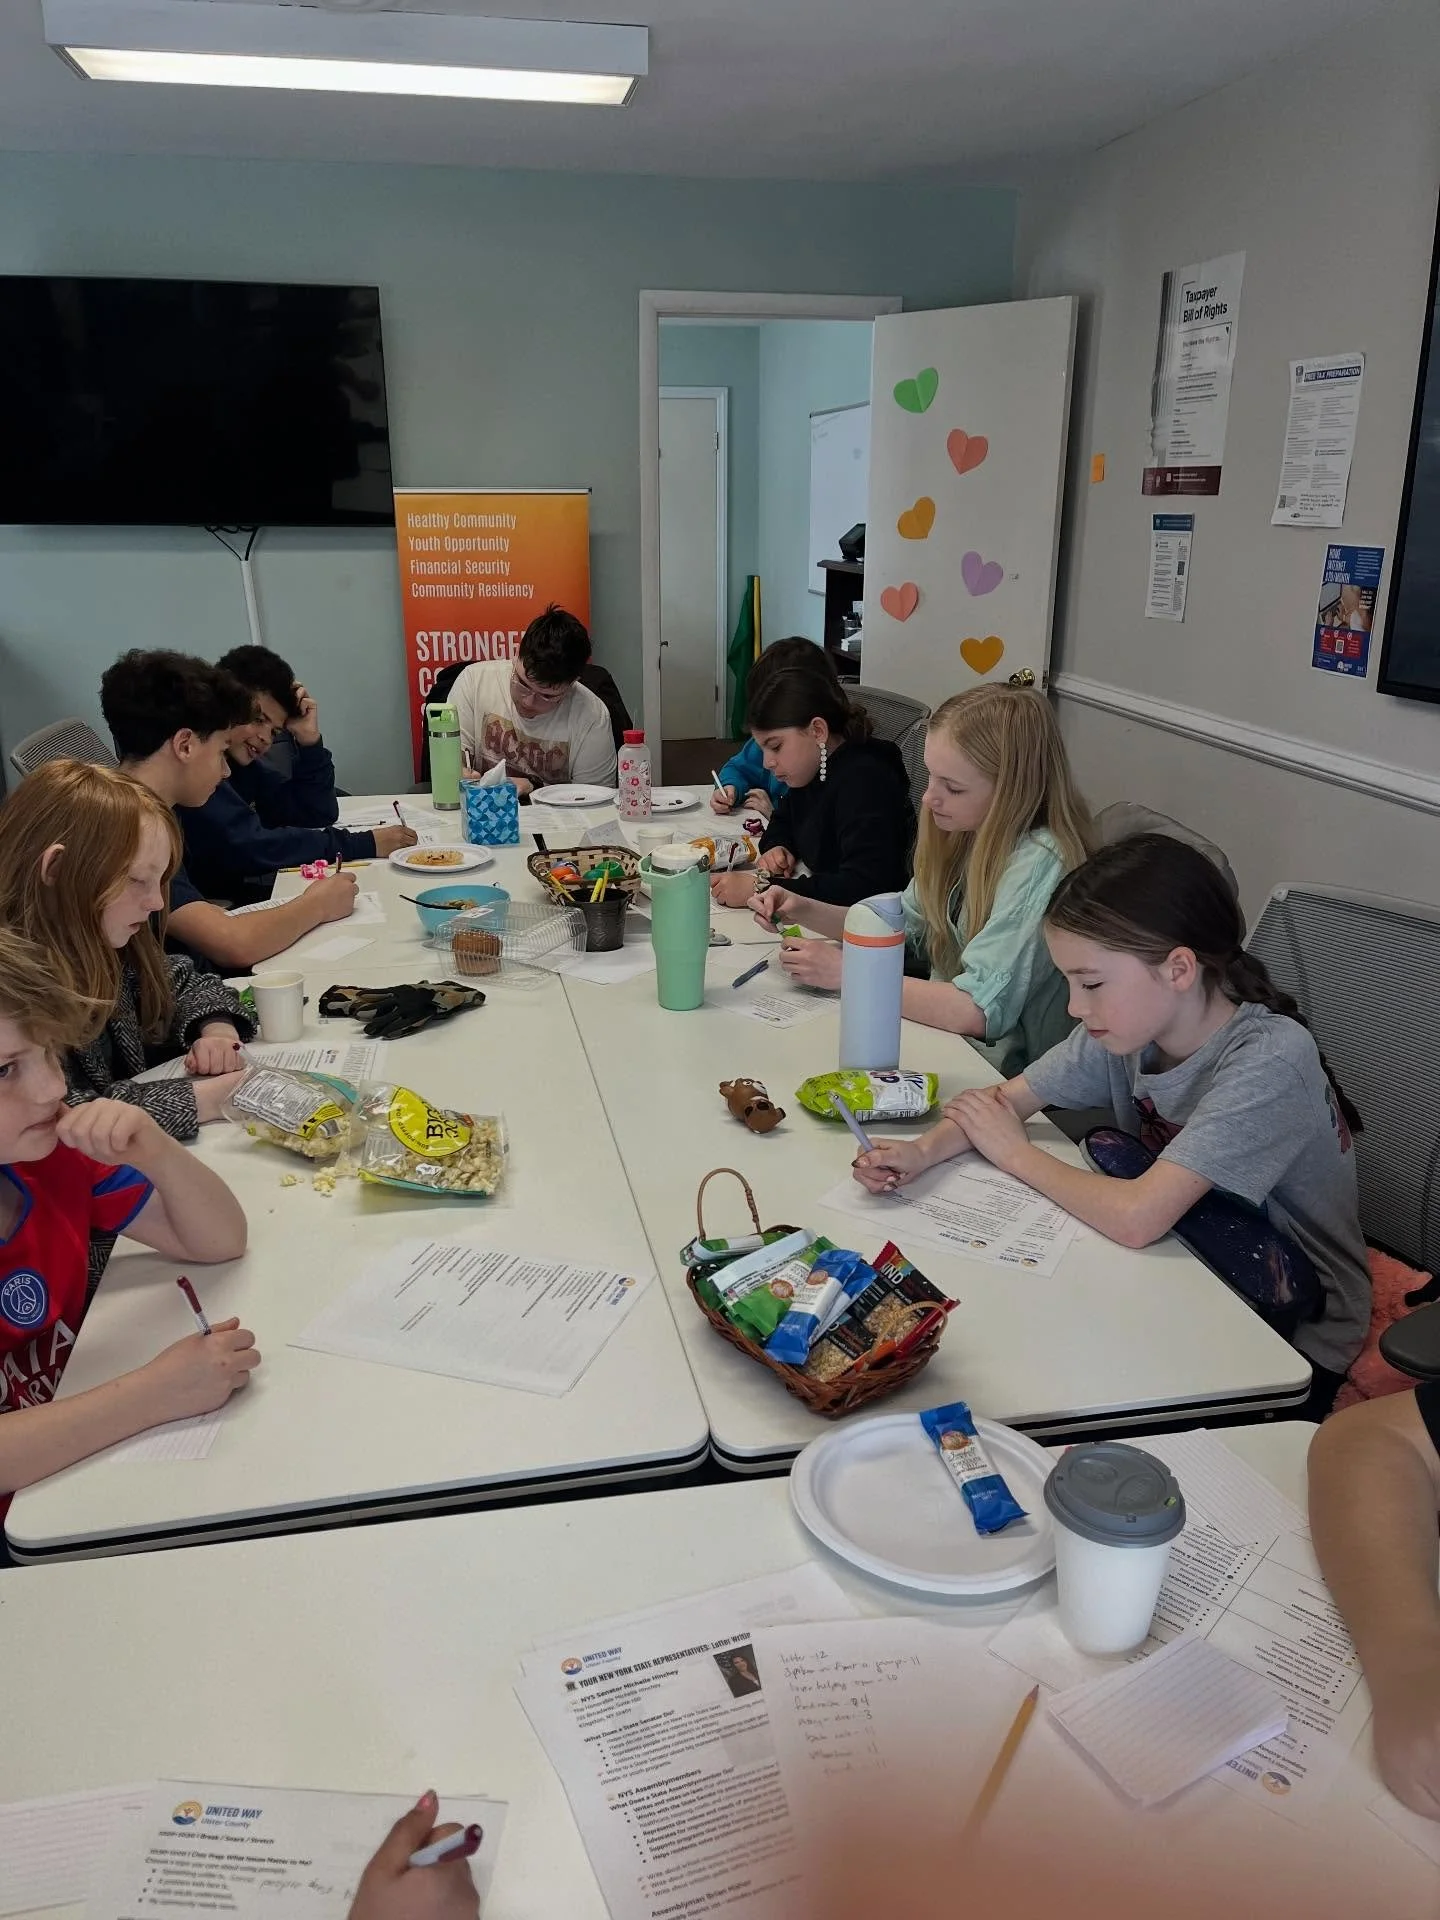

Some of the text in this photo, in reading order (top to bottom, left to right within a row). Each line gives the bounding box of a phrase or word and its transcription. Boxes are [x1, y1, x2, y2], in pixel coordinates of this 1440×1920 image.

[1186, 287, 1218, 303] Taxpayer
[1184, 308, 1194, 322] Bill
[1204, 302, 1228, 320] Rights
[408, 513, 516, 529] Healthy Community
[408, 536, 510, 552] Youth Opportunity
[410, 560, 510, 576] Financial Security
[412, 583, 534, 599] Community Resiliency
[416, 630, 525, 662] STRONGE
[4, 1277, 31, 1296] PARIS
[578, 1632, 751, 1687] YOUR NEW YORK STATE REPRESENTATIVES: Letter Writin
[582, 1647, 622, 1662] UNITED WAY
[596, 1686, 622, 1697] Senator
[623, 1678, 650, 1688] Michelle
[617, 1769, 701, 1798] NYS Assemblymembers
[205, 1806, 262, 1820] UNITED WAY
[609, 1802, 627, 1810] What
[224, 1820, 251, 1829] County
